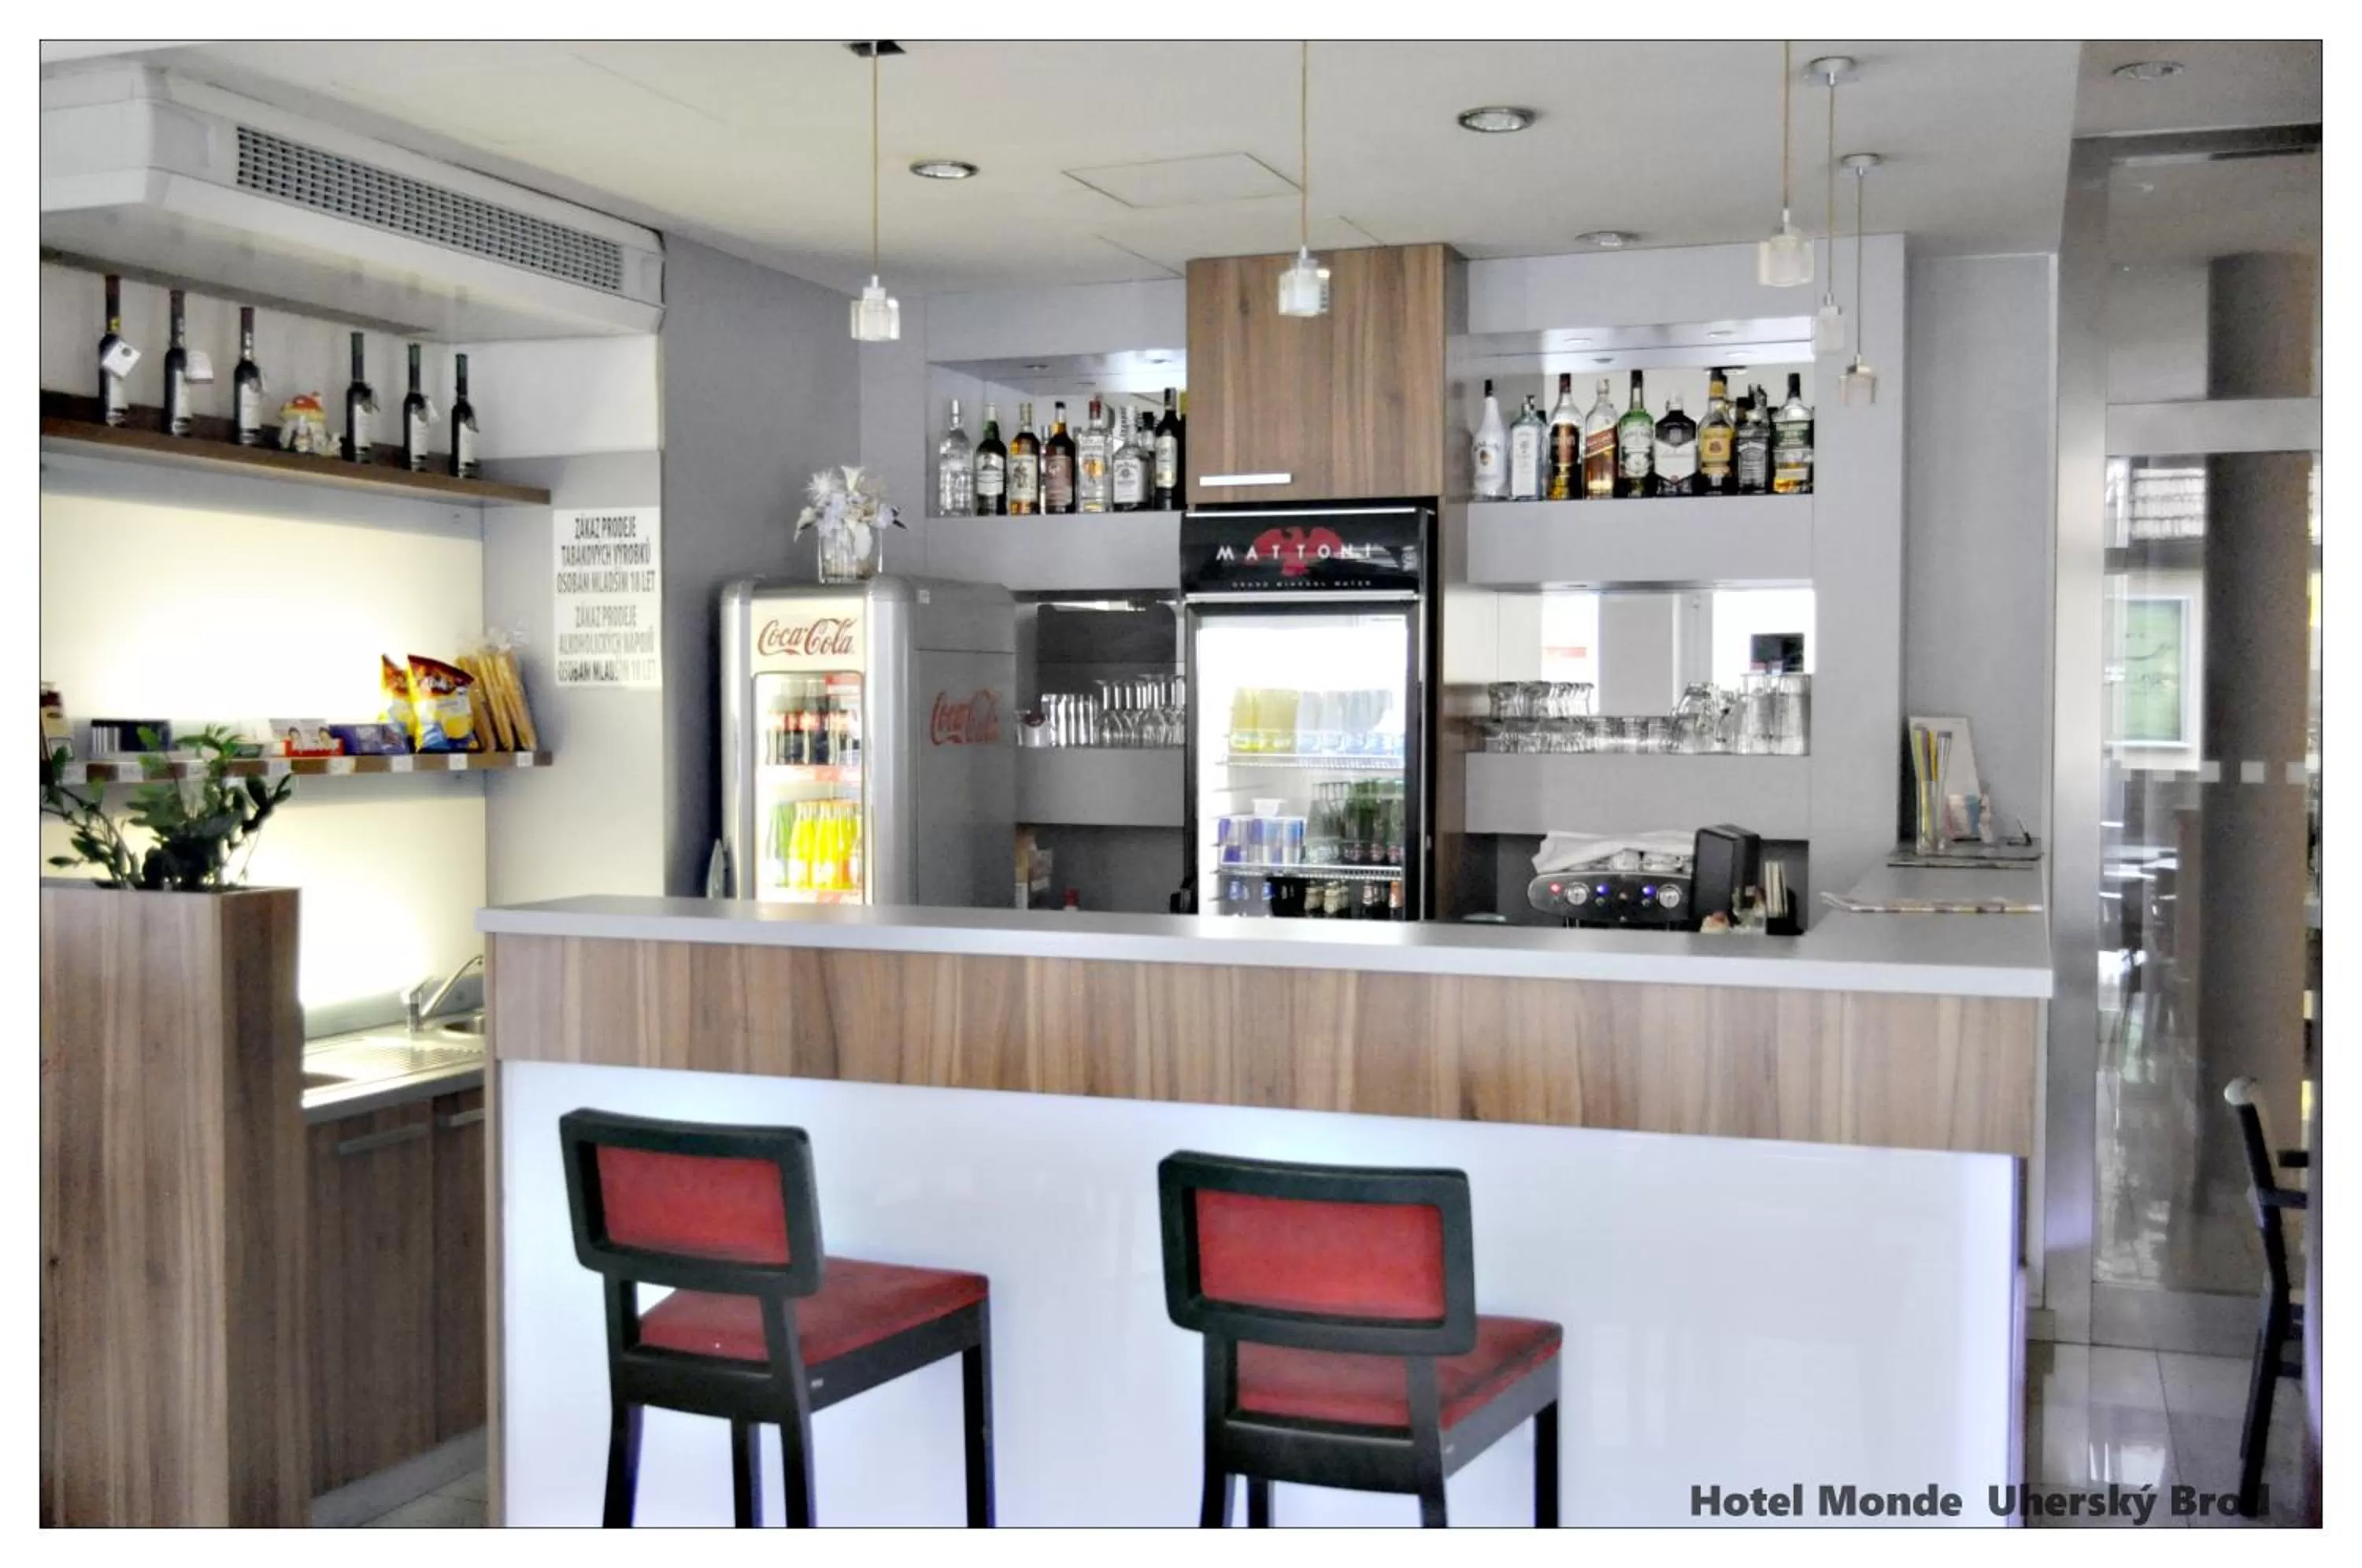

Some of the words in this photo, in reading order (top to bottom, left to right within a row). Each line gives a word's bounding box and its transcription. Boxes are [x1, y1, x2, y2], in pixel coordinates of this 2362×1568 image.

[602, 516, 636, 538] PRODEJE
[1216, 542, 1372, 561] MATTONI
[642, 570, 655, 592] LET
